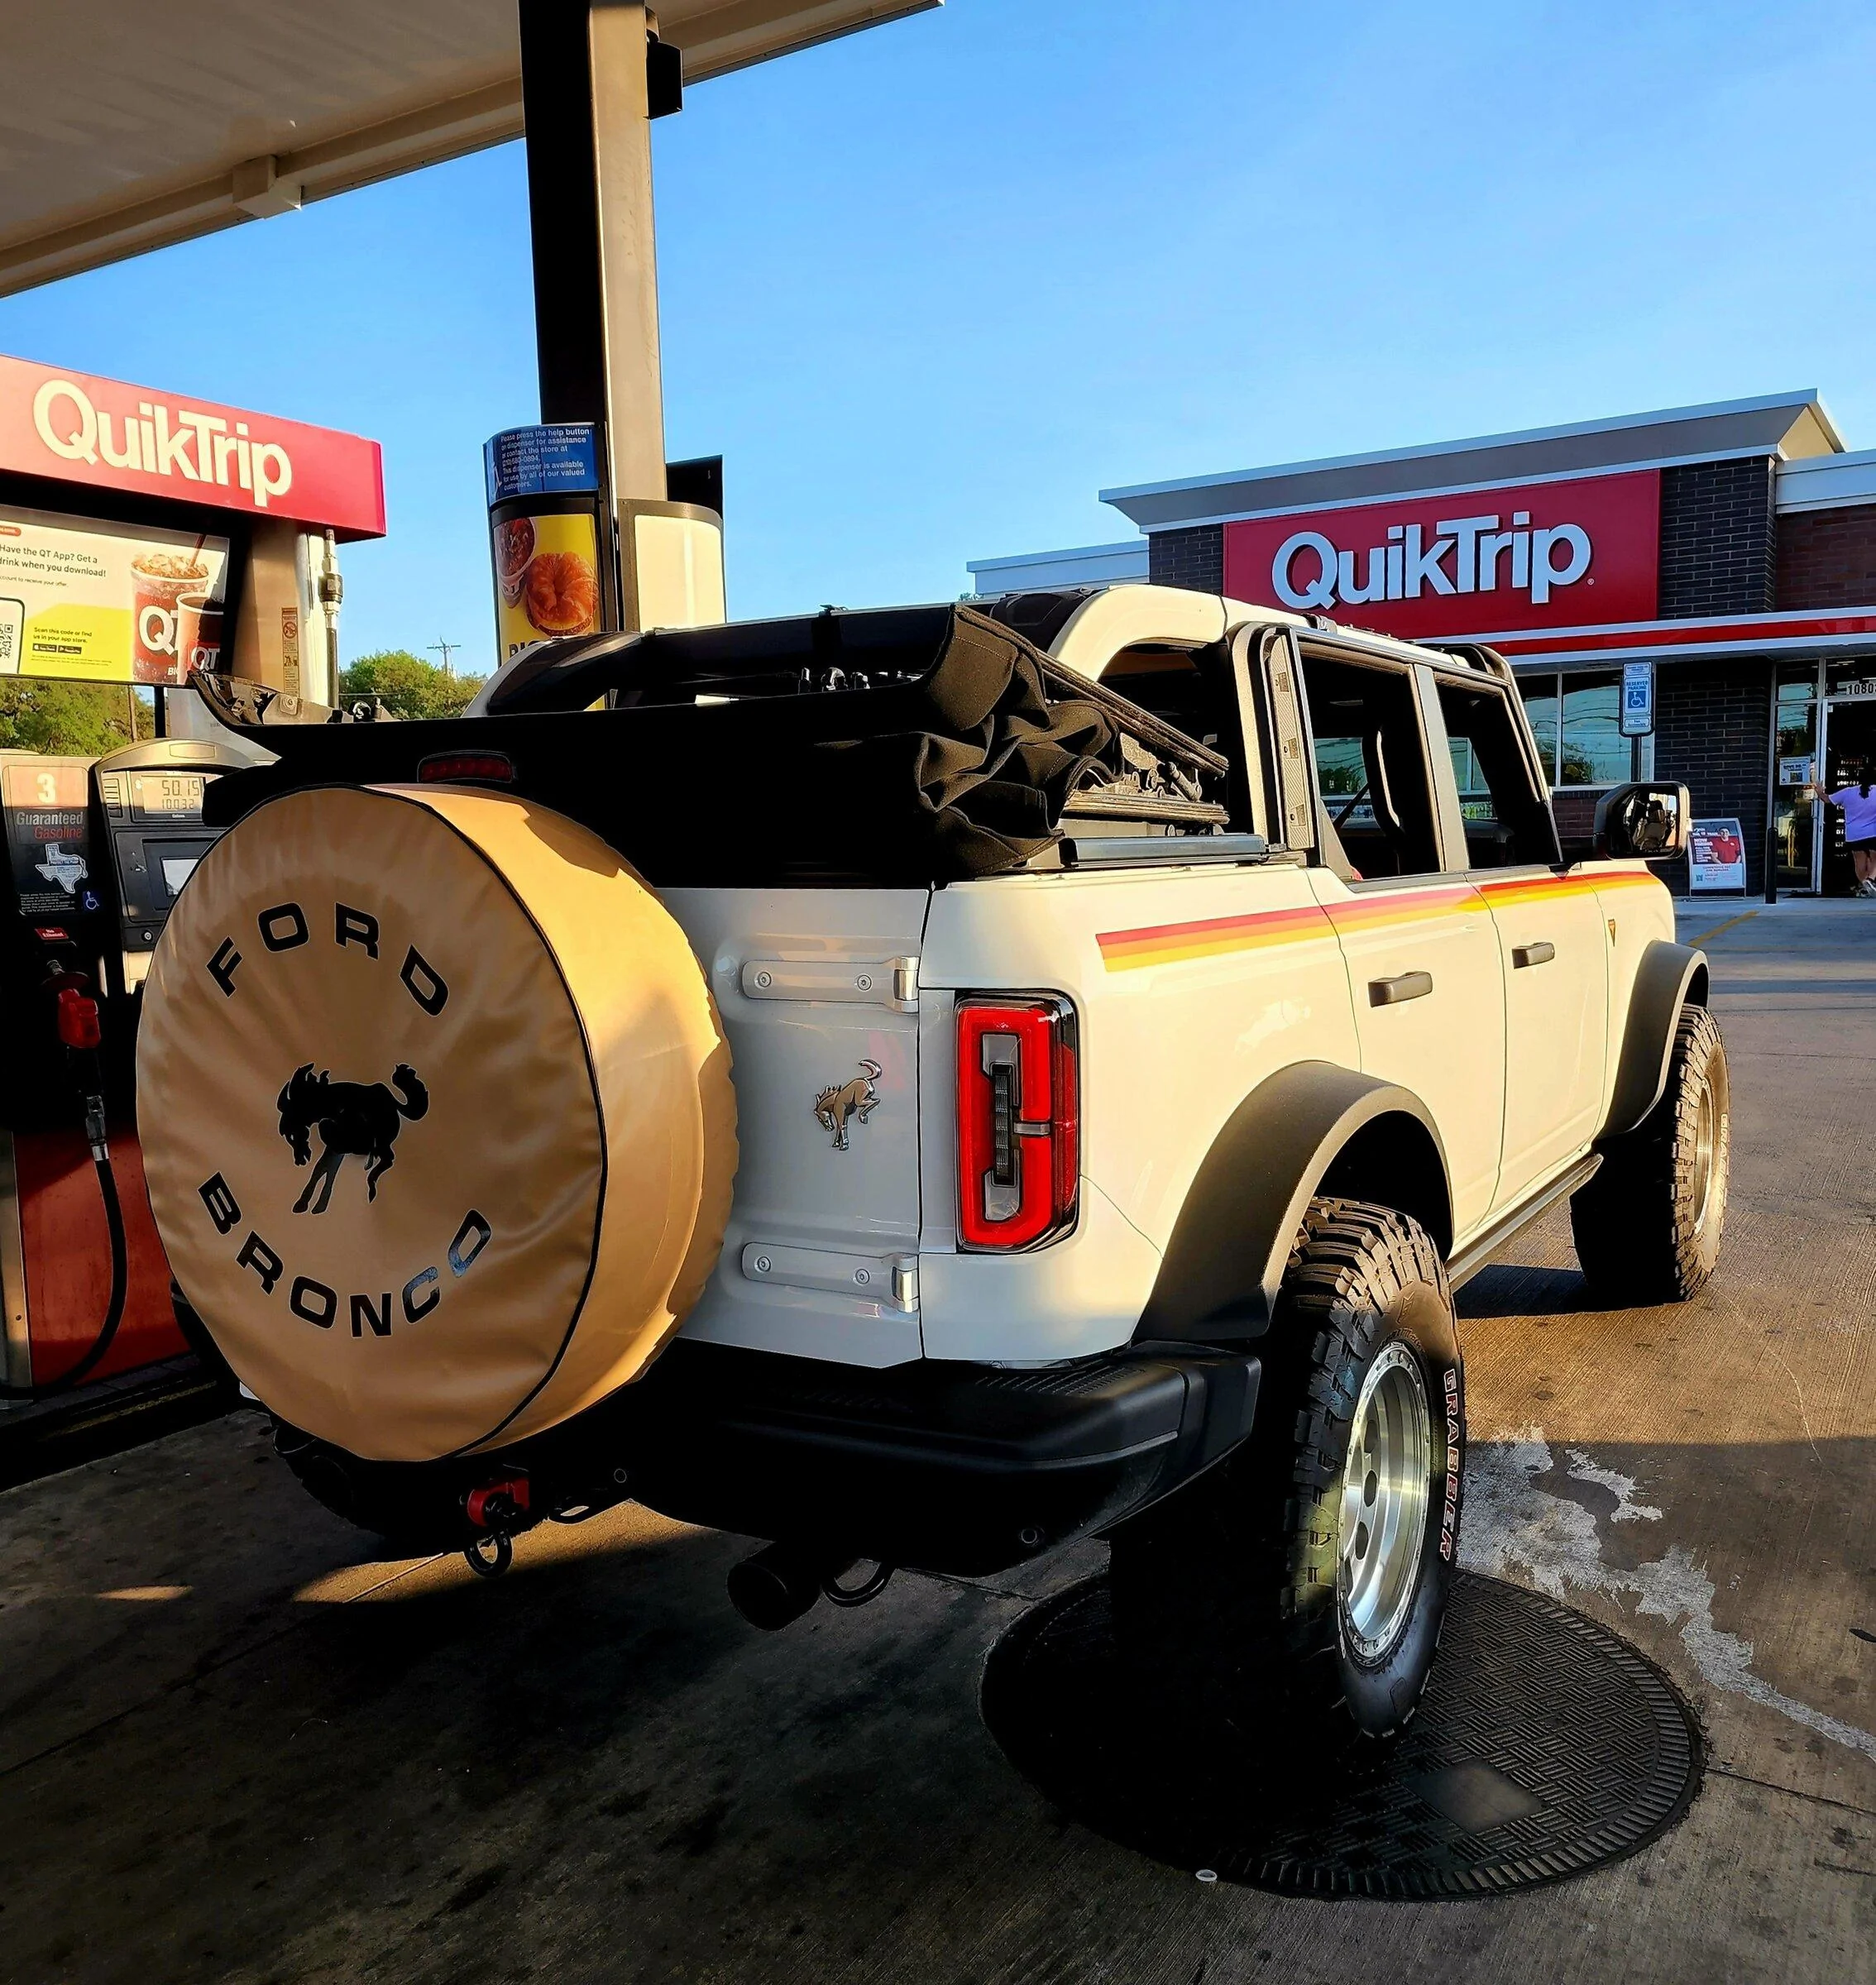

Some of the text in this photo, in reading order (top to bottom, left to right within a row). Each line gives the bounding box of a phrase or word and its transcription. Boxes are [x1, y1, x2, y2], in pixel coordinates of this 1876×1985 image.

[33, 380, 293, 507] QuikTrip
[516, 431, 534, 440] press
[548, 428, 563, 437] help
[0, 544, 21, 554] Have
[23, 547, 37, 557] the
[40, 549, 51, 557] QT
[54, 551, 74, 561] App?
[76, 554, 91, 562] Get
[1271, 510, 1591, 610] QuikTrip
[22, 560, 45, 570] when
[64, 565, 107, 577] download!
[191, 647, 220, 671] QT
[36, 772, 55, 803] 3
[161, 780, 199, 796] 50.15
[161, 799, 194, 809] 10.032
[17, 811, 84, 825] Guaranteed
[34, 826, 83, 839] Gasoline
[206, 902, 449, 1016] FORD
[198, 1171, 492, 1338] BRONCO
[1439, 1369, 1459, 1562] GRABBER
